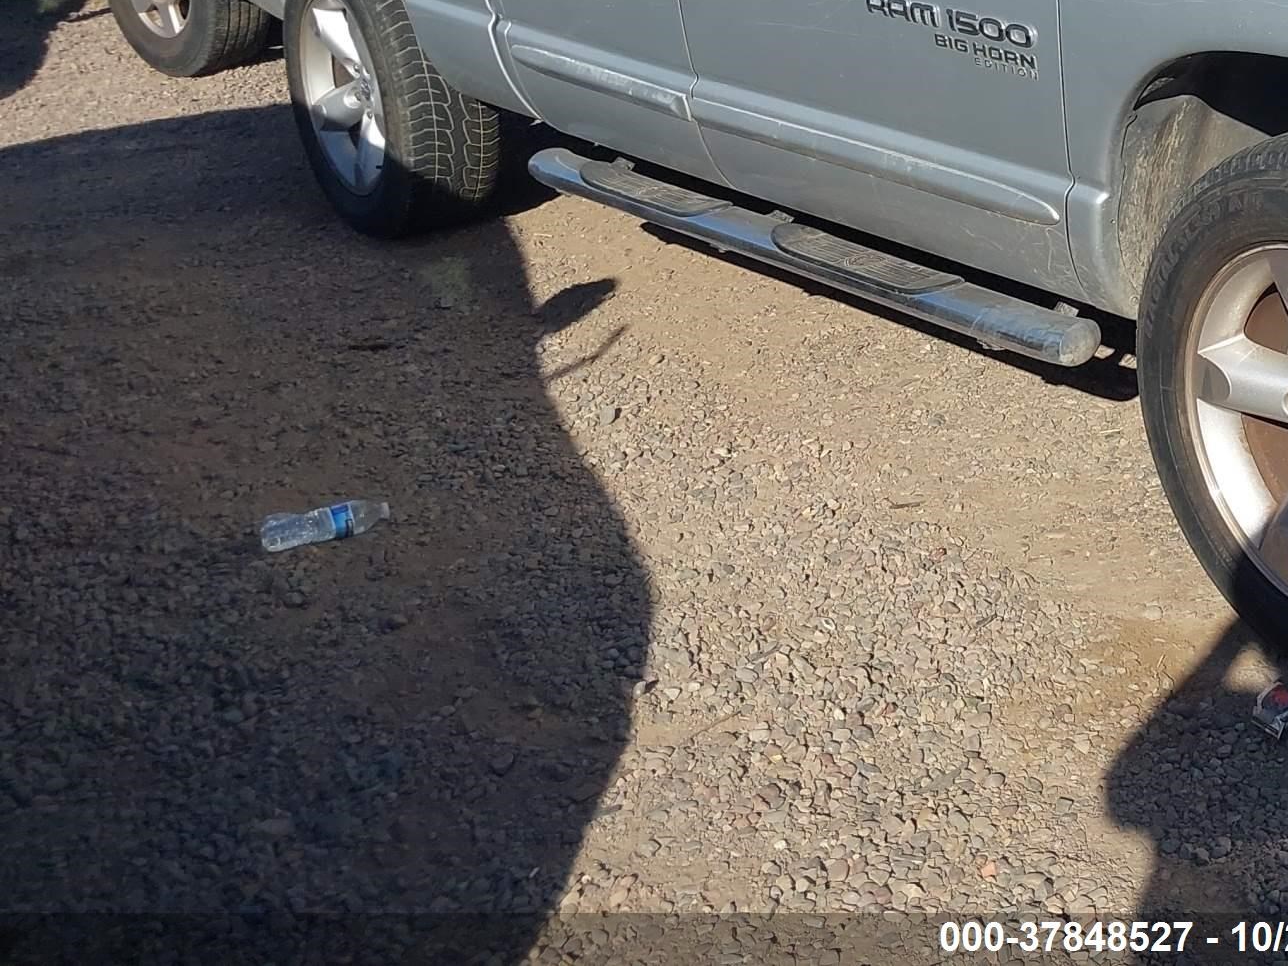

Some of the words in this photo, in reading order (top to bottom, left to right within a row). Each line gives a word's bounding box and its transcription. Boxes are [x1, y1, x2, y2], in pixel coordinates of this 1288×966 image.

[946, 8, 1038, 48] 1500
[934, 33, 969, 53] BIG
[972, 42, 1037, 69] HORN
[974, 57, 1039, 81] EDITION
